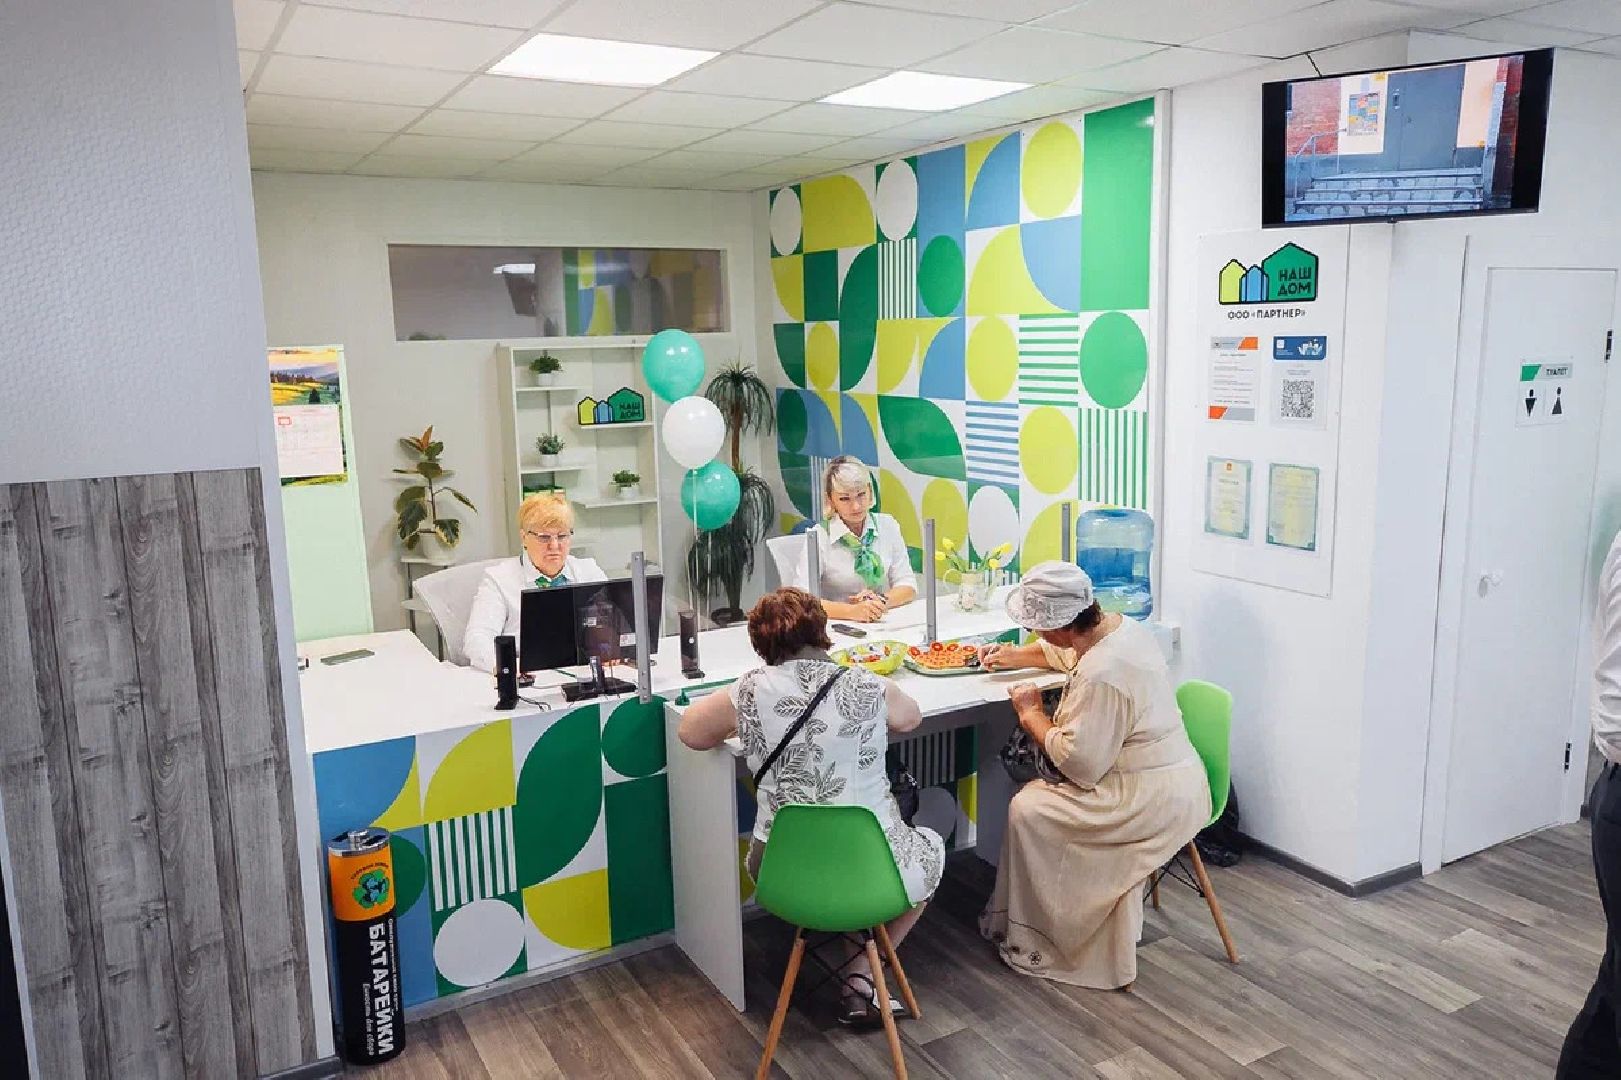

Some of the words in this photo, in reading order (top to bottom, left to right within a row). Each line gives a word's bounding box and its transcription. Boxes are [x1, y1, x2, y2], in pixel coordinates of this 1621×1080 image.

[1278, 267, 1312, 281] НАШ
[1277, 282, 1312, 297] ДОМ
[1227, 310, 1250, 320] ООО
[1251, 308, 1306, 319] «ПАРТНЕР»
[369, 922, 395, 1055] БАТАРЕЙКИ
